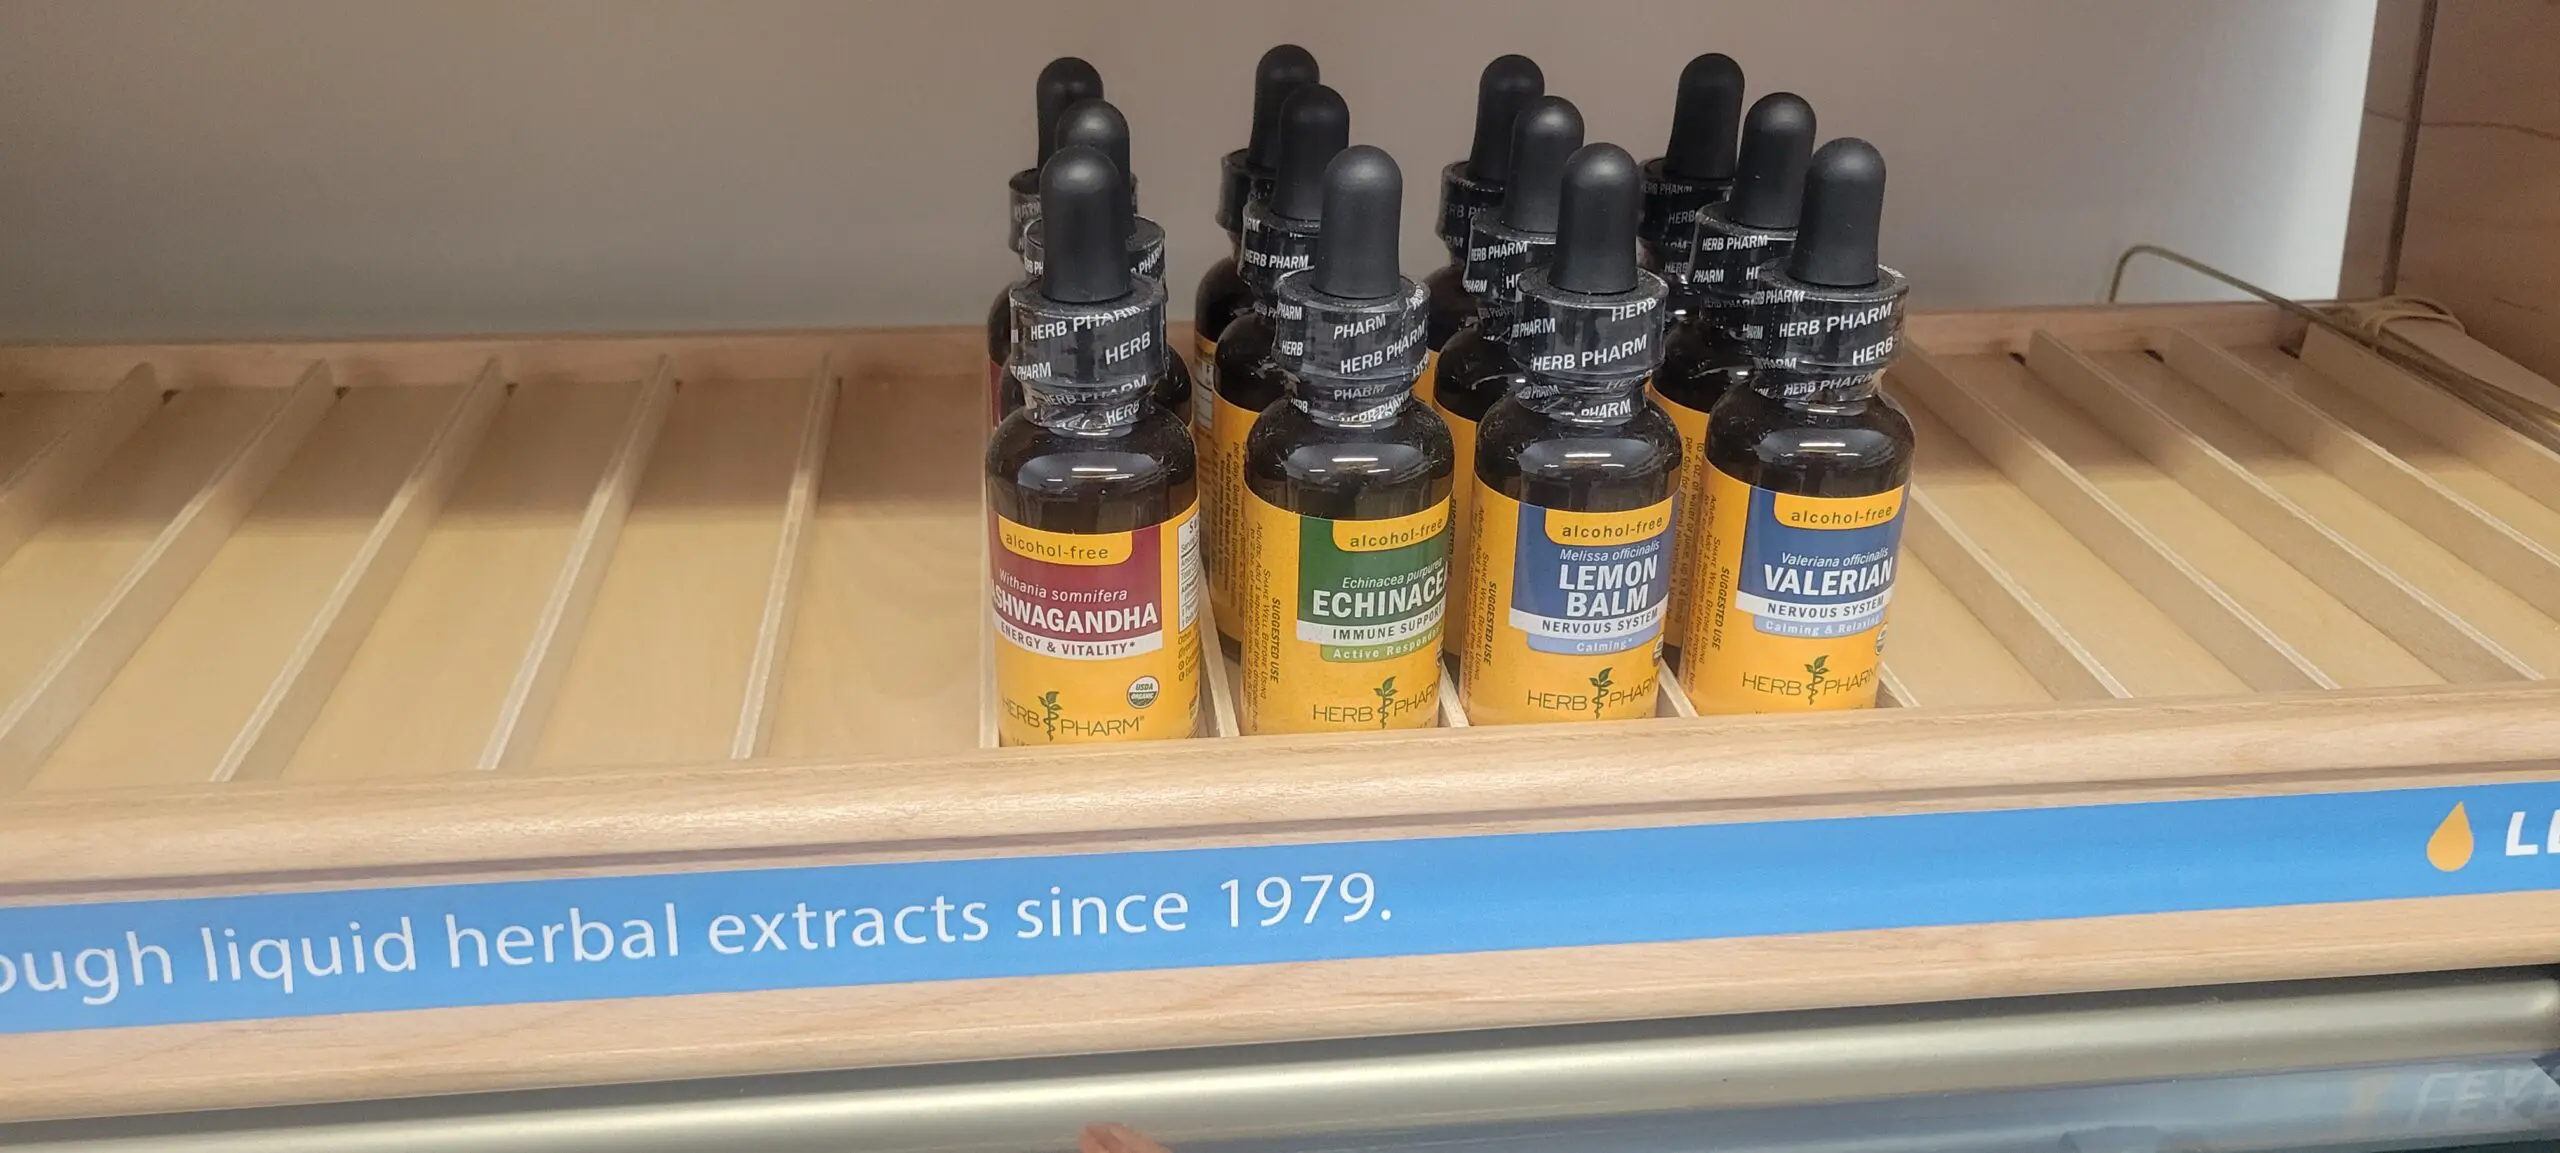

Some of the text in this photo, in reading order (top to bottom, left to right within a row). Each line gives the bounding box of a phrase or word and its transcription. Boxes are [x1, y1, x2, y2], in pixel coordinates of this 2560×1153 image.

[1488, 242, 1529, 261] PHARM
[1702, 234, 1769, 251] HERB PHARM
[1268, 254, 1310, 270] PHARM
[1693, 269, 1724, 283] PHARM
[1765, 289, 1805, 305] PHARM
[1031, 304, 1141, 341] HERB PHARM
[1278, 303, 1303, 321] PHARM
[1612, 297, 1657, 323] HERB
[1779, 301, 1893, 338] HERB PHARM
[1333, 313, 1387, 340] PHARM
[1520, 317, 1556, 338] PHARM
[1105, 331, 1151, 365] HERB
[1282, 340, 1303, 356] HERB
[1340, 319, 1426, 374] HERB PHARM
[1532, 334, 1648, 372] HERB PHARM
[1852, 336, 1893, 366] HERB
[1016, 361, 1051, 381] PHARM
[1783, 382, 1817, 396] HERB
[1105, 401, 1141, 426] HERB
[1581, 398, 1632, 418] PHARM
[1684, 436, 1694, 452] per
[1683, 455, 1693, 474] day
[1682, 475, 1691, 491] for
[1688, 494, 1698, 521] water
[1791, 505, 1893, 524] alcohol-free
[1350, 518, 1443, 547] alcohol-free
[1562, 516, 1663, 538] alcohol-free
[1686, 523, 1694, 534] or
[1006, 533, 1109, 560] alcohol-free
[1559, 539, 1660, 561] Melissa officinalis
[1711, 537, 1721, 569] SHAKE
[1782, 546, 1889, 566] Valeriana officinalis
[1342, 574, 1404, 589] Echinacea
[1406, 557, 1443, 584] purpurea
[1559, 554, 1657, 590] LEMON
[1707, 571, 1717, 597] WELL
[1764, 556, 1893, 596] VALERIAN
[1000, 567, 1128, 603] Withania somnifera
[1263, 569, 1271, 601] SHAKE
[1566, 583, 1649, 617] BALM
[1712, 566, 1730, 652] SUGGESTED USE
[1767, 595, 1884, 618] NERVOUS SYSTEM
[1262, 604, 1270, 629] WELL
[1333, 603, 1443, 640] IMMUNE SUPPORT
[1484, 581, 1497, 667] SUGGESTED USE
[1542, 607, 1658, 634] NERVOUS SYSTEM
[1766, 620, 1819, 636] Calming
[1824, 626, 1834, 635] &
[1001, 622, 1041, 649] ENERGY
[1046, 641, 1056, 653] &
[1270, 597, 1281, 684] SUGGESTED USE
[1333, 648, 1379, 659] Active
[1742, 671, 1802, 696] HERB
[1528, 690, 1587, 710] HERB
[1313, 704, 1374, 723] HERB
[201, 916, 417, 993] liquid
[446, 903, 679, 968] herbal
[708, 893, 990, 955] extracts
[1017, 885, 1190, 939] since
[1220, 871, 1394, 928] 1979.
